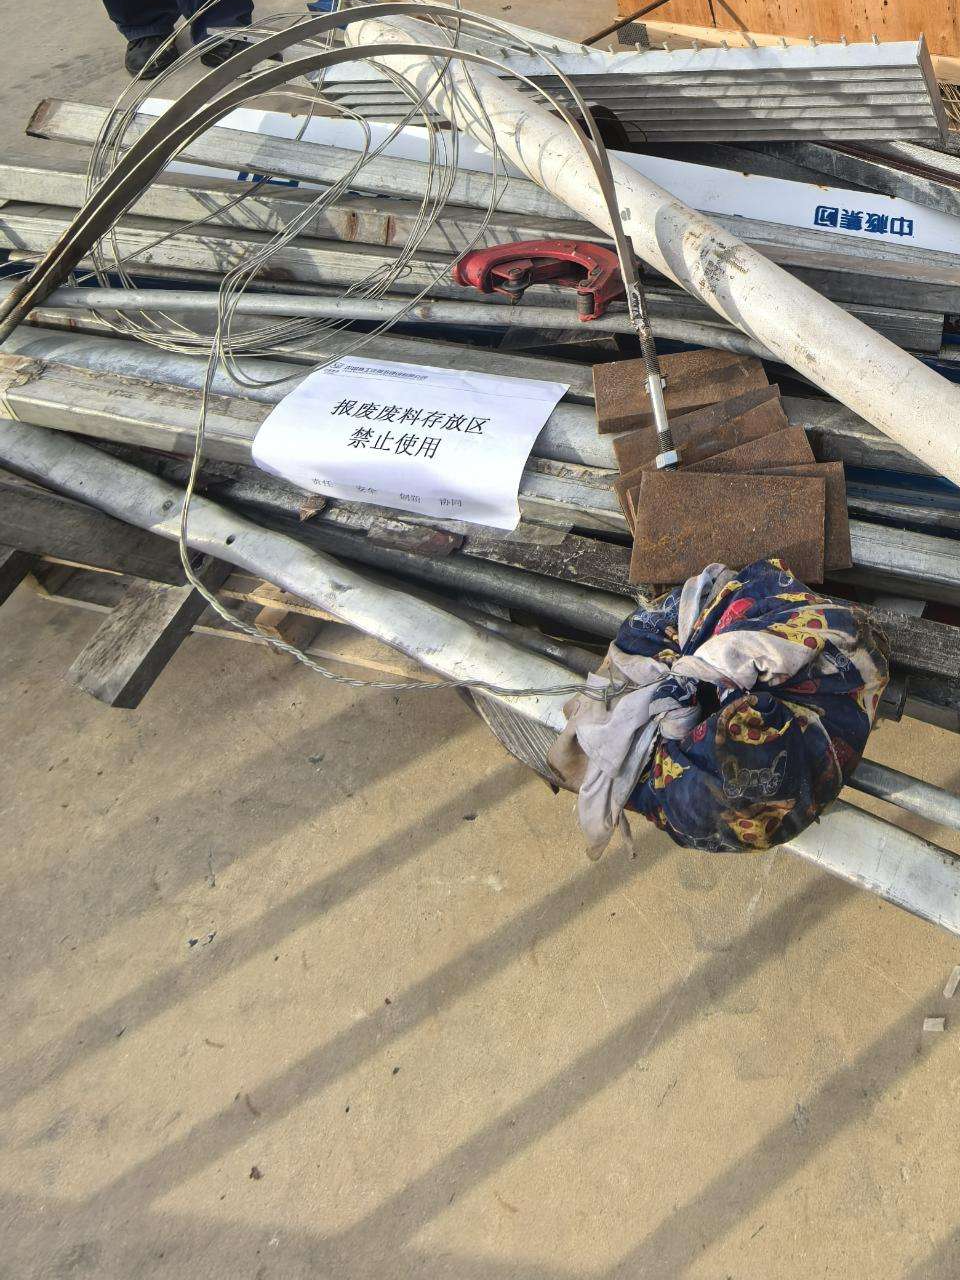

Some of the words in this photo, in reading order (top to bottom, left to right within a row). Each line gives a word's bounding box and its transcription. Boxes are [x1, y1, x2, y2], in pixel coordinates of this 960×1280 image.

[814, 205, 914, 236] 中核集团
[330, 398, 491, 436] 报废废料存放区
[347, 426, 442, 459] 禁止使用
